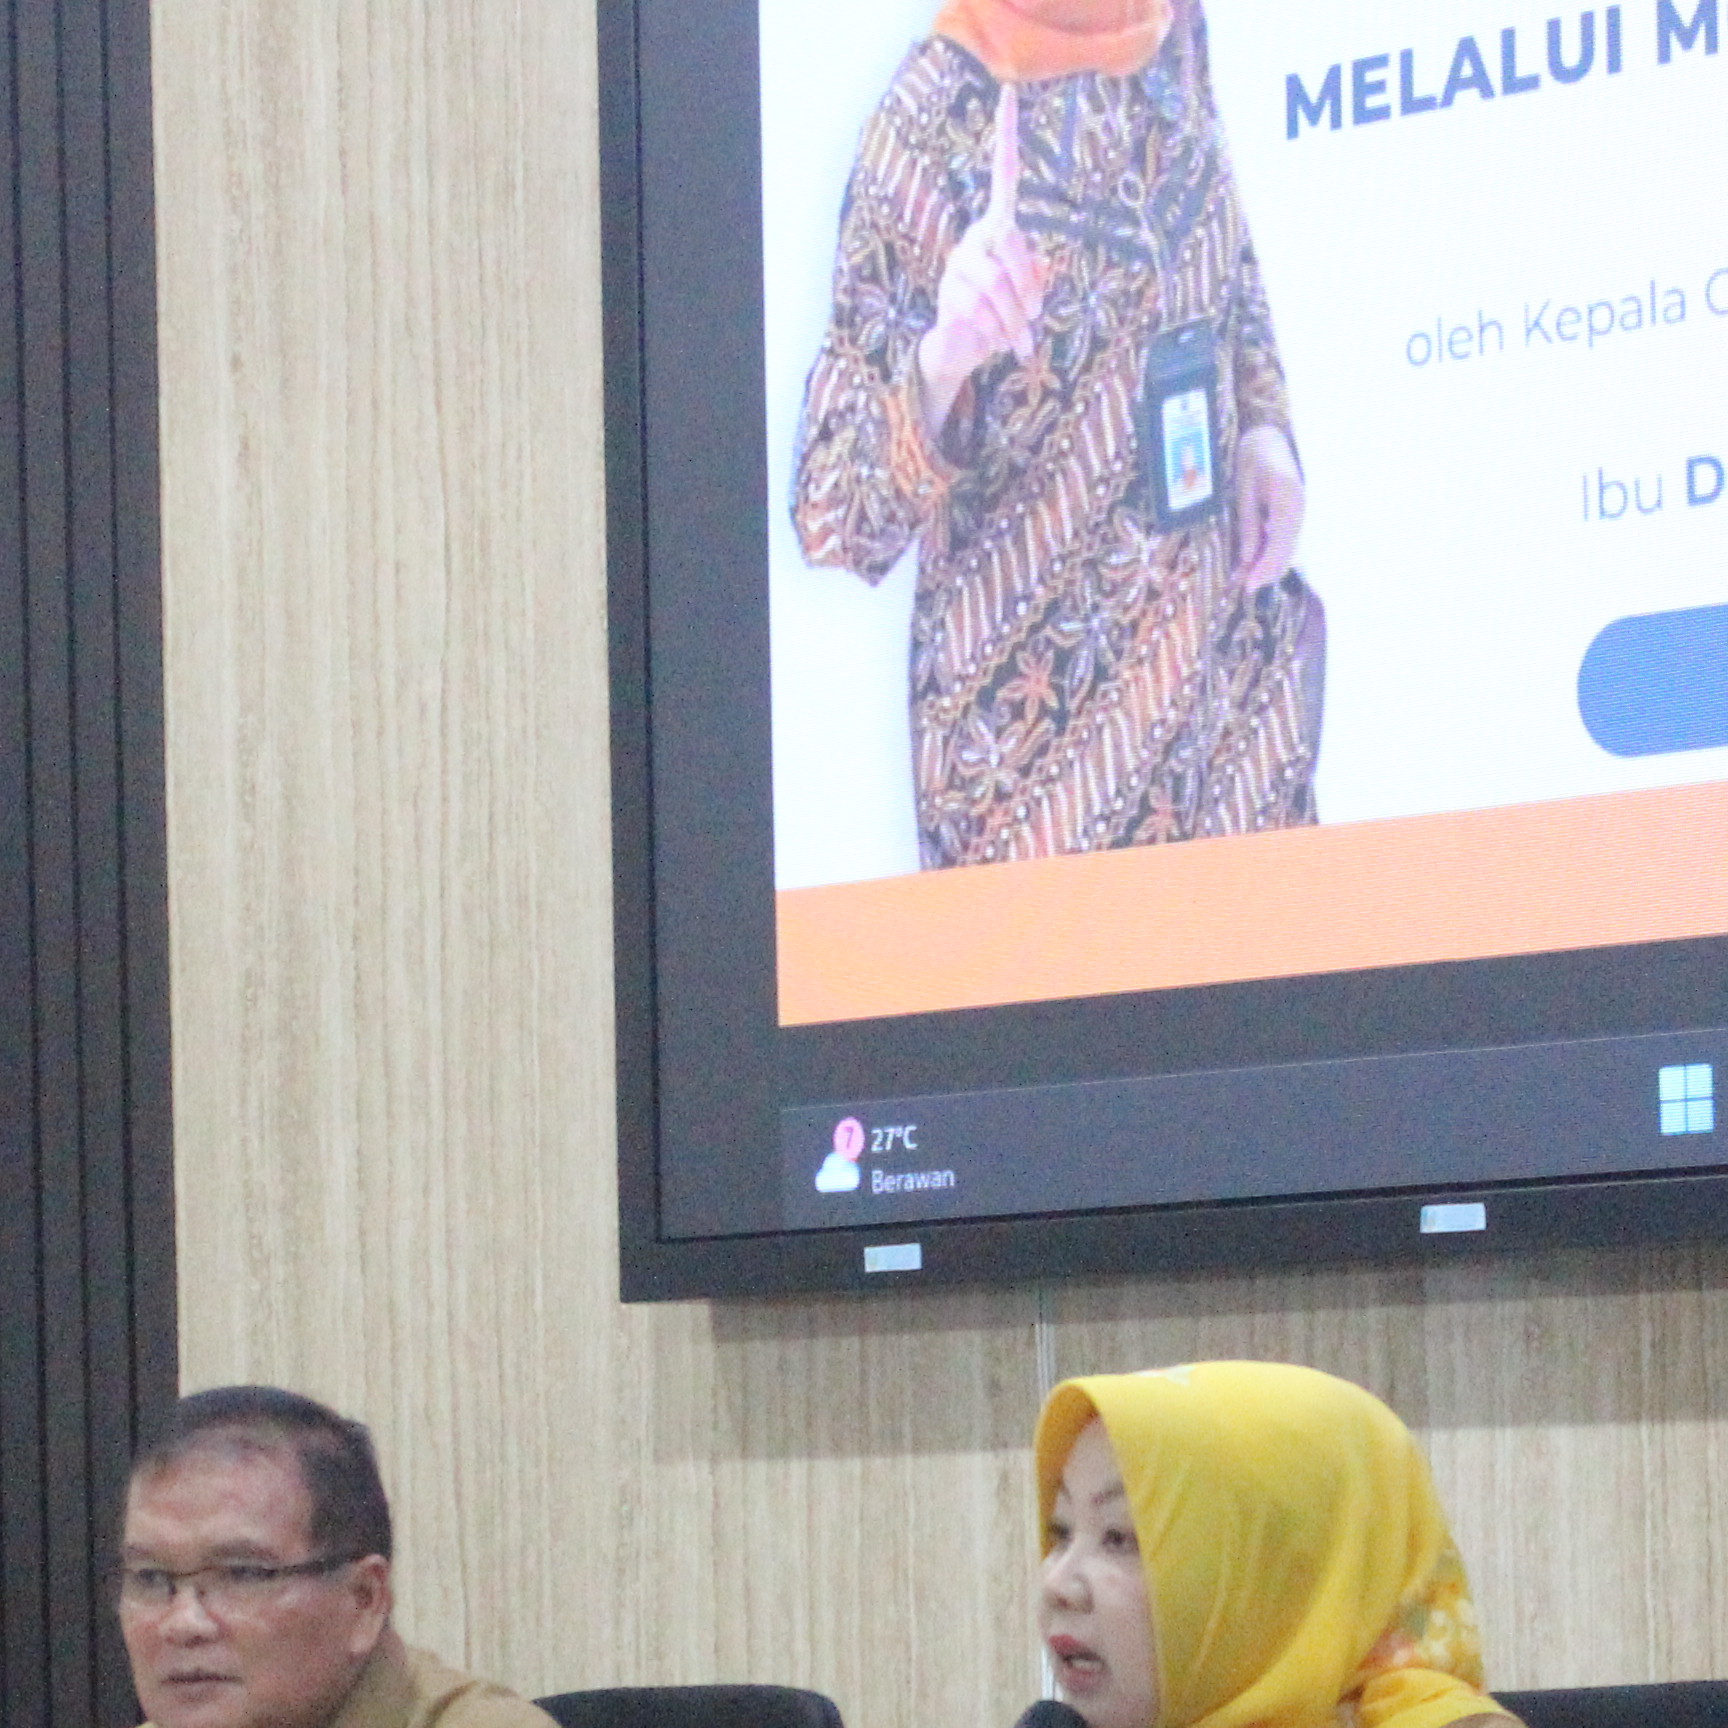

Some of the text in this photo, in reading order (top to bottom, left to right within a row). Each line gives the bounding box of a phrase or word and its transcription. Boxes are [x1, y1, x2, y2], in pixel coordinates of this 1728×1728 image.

[1284, 4, 1622, 141] MELALUI
[1405, 308, 1504, 368] oleh
[1523, 278, 1686, 350] Kepala
[1580, 466, 1665, 523] Ibu
[871, 1168, 956, 1195] Berawan
